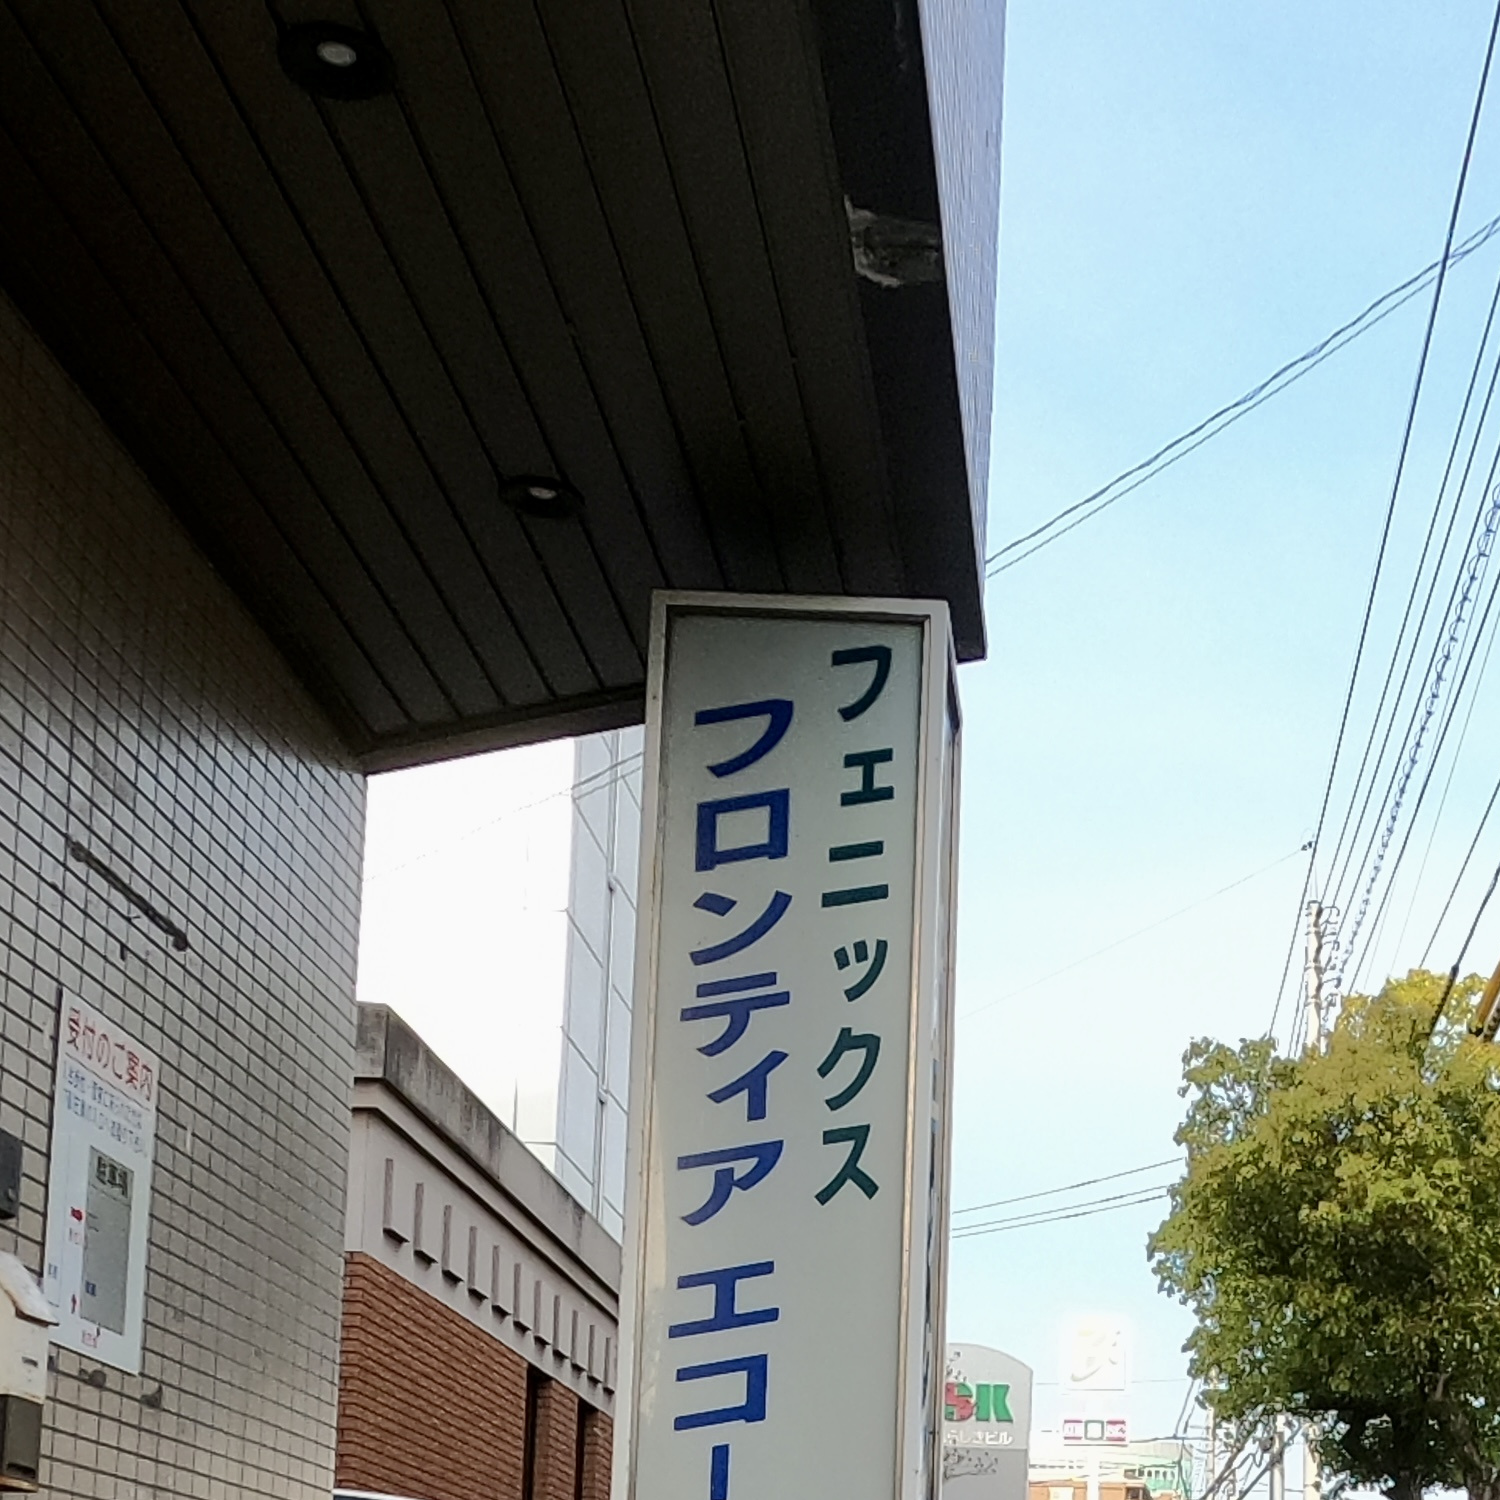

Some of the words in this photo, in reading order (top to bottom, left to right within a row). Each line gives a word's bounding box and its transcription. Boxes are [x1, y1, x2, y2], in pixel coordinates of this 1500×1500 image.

[66, 1006, 153, 1102] 受付のご案内
[814, 645, 895, 1206] フェニックス
